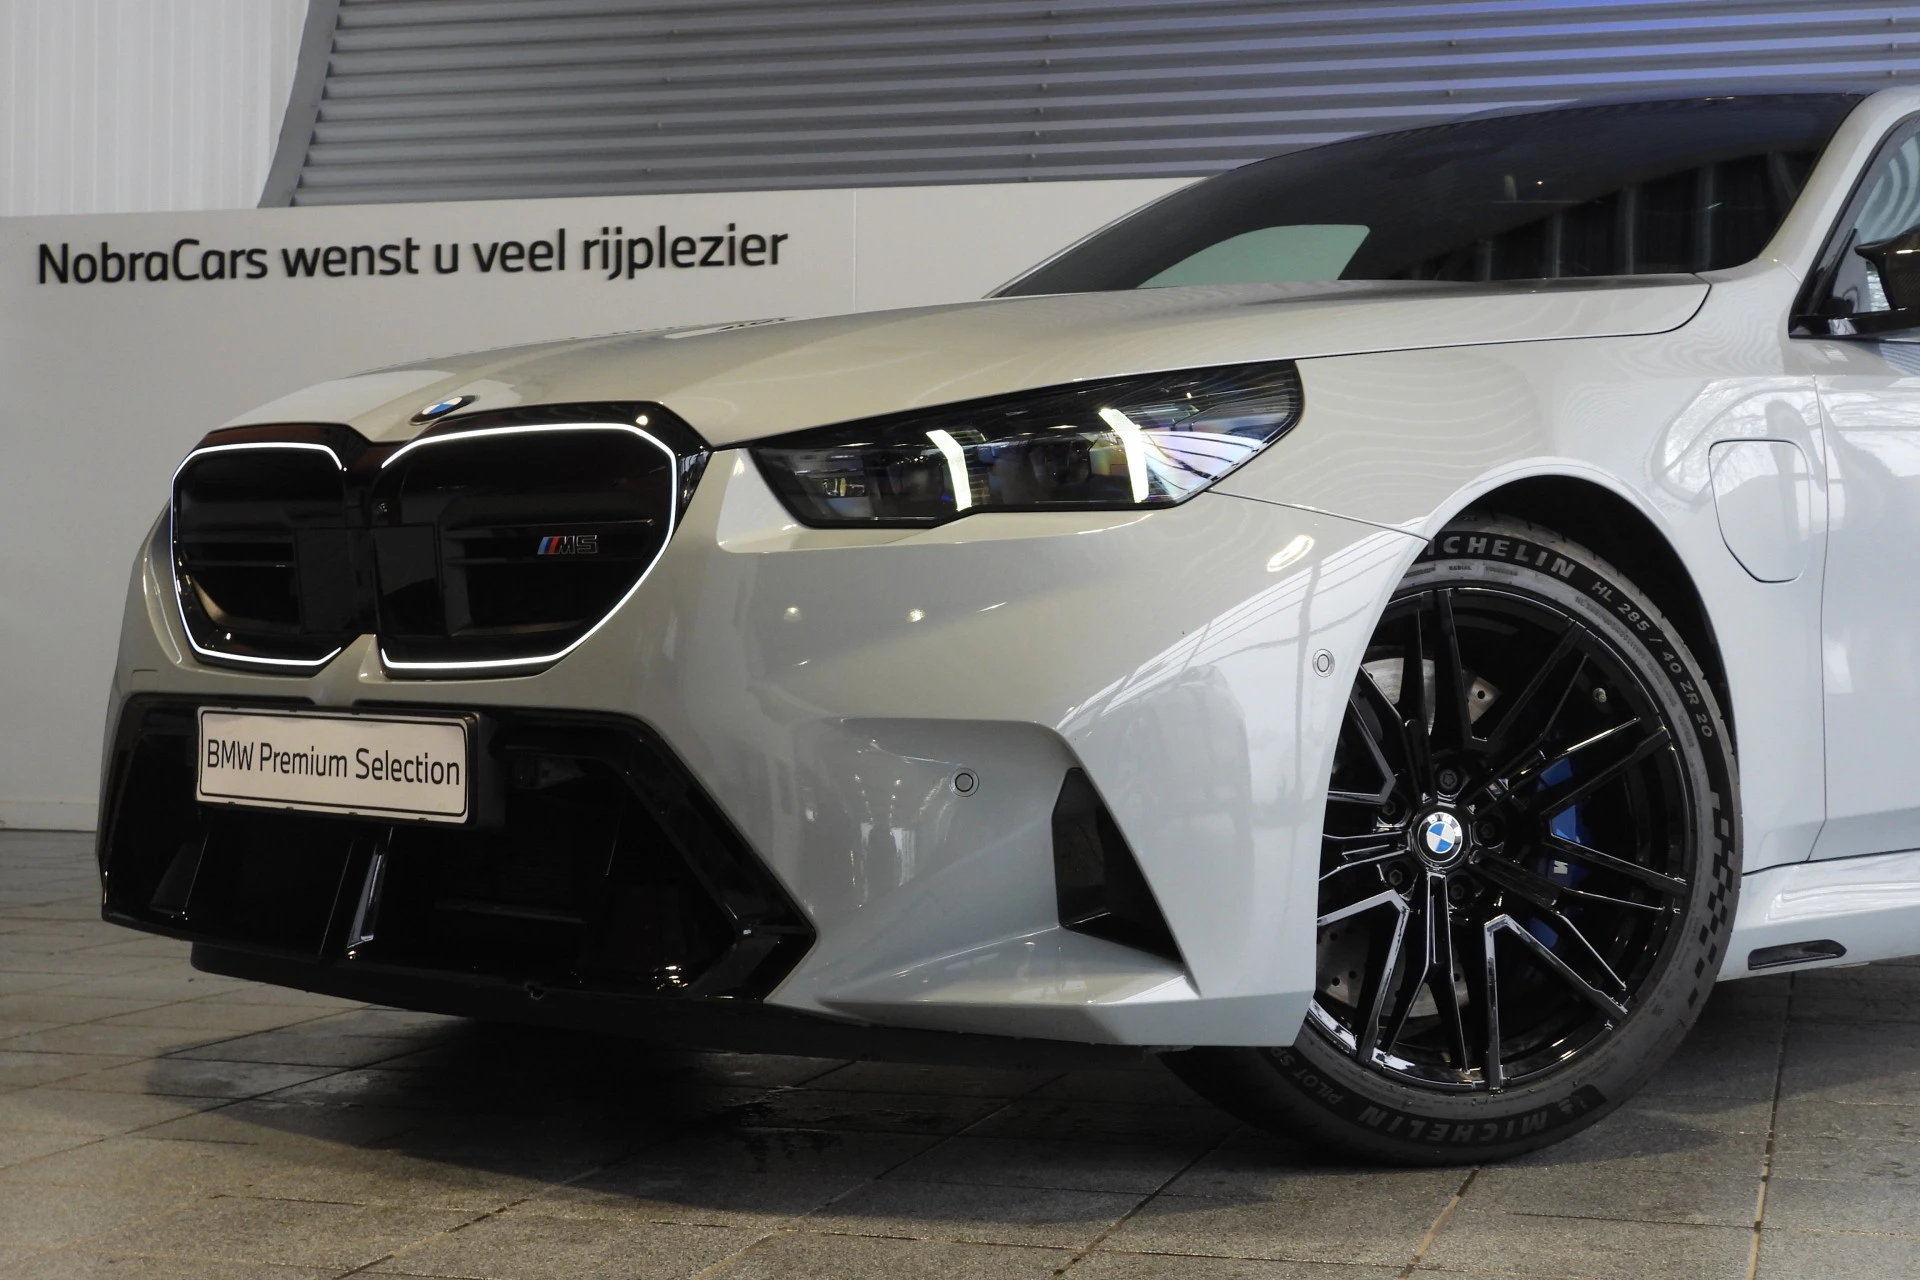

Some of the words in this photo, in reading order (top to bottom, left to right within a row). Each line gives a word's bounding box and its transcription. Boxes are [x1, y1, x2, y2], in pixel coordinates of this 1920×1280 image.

[38, 238, 268, 285] NobraCars
[282, 237, 421, 278] wenst
[434, 243, 459, 275] u
[472, 228, 566, 273] veel
[583, 222, 789, 281] rijplezier
[558, 534, 598, 555] M5
[1427, 535, 1576, 578] ICHELIN
[1591, 581, 1613, 603] HL
[1617, 603, 1650, 632] 285
[1661, 651, 1682, 674] 40
[1680, 681, 1700, 706] ZR
[1697, 713, 1714, 738] 20
[207, 738, 255, 771] BMW
[259, 742, 348, 778] Premium
[355, 747, 461, 786] Selection
[1292, 1068, 1345, 1105] PILOT
[1357, 1105, 1548, 1143] MICHELIN
